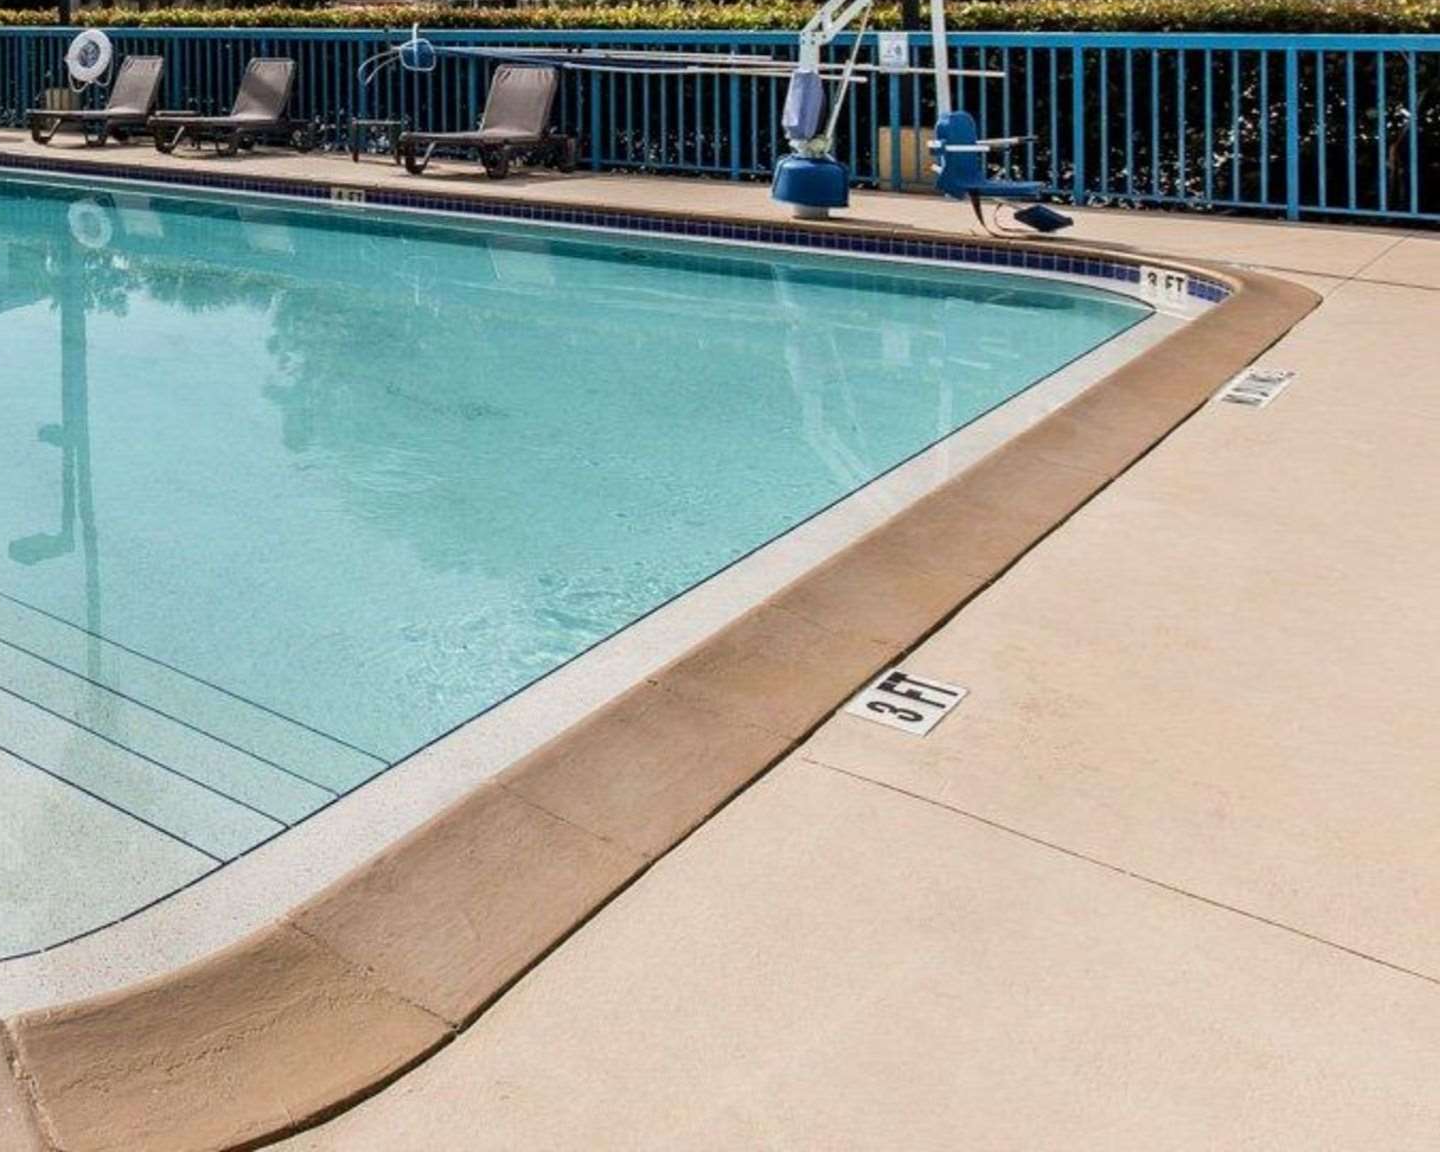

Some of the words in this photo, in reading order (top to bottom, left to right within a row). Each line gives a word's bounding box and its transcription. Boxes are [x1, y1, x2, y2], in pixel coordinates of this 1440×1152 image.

[1165, 275, 1184, 292] FT
[876, 671, 959, 710] FT
[866, 700, 924, 723] 3
